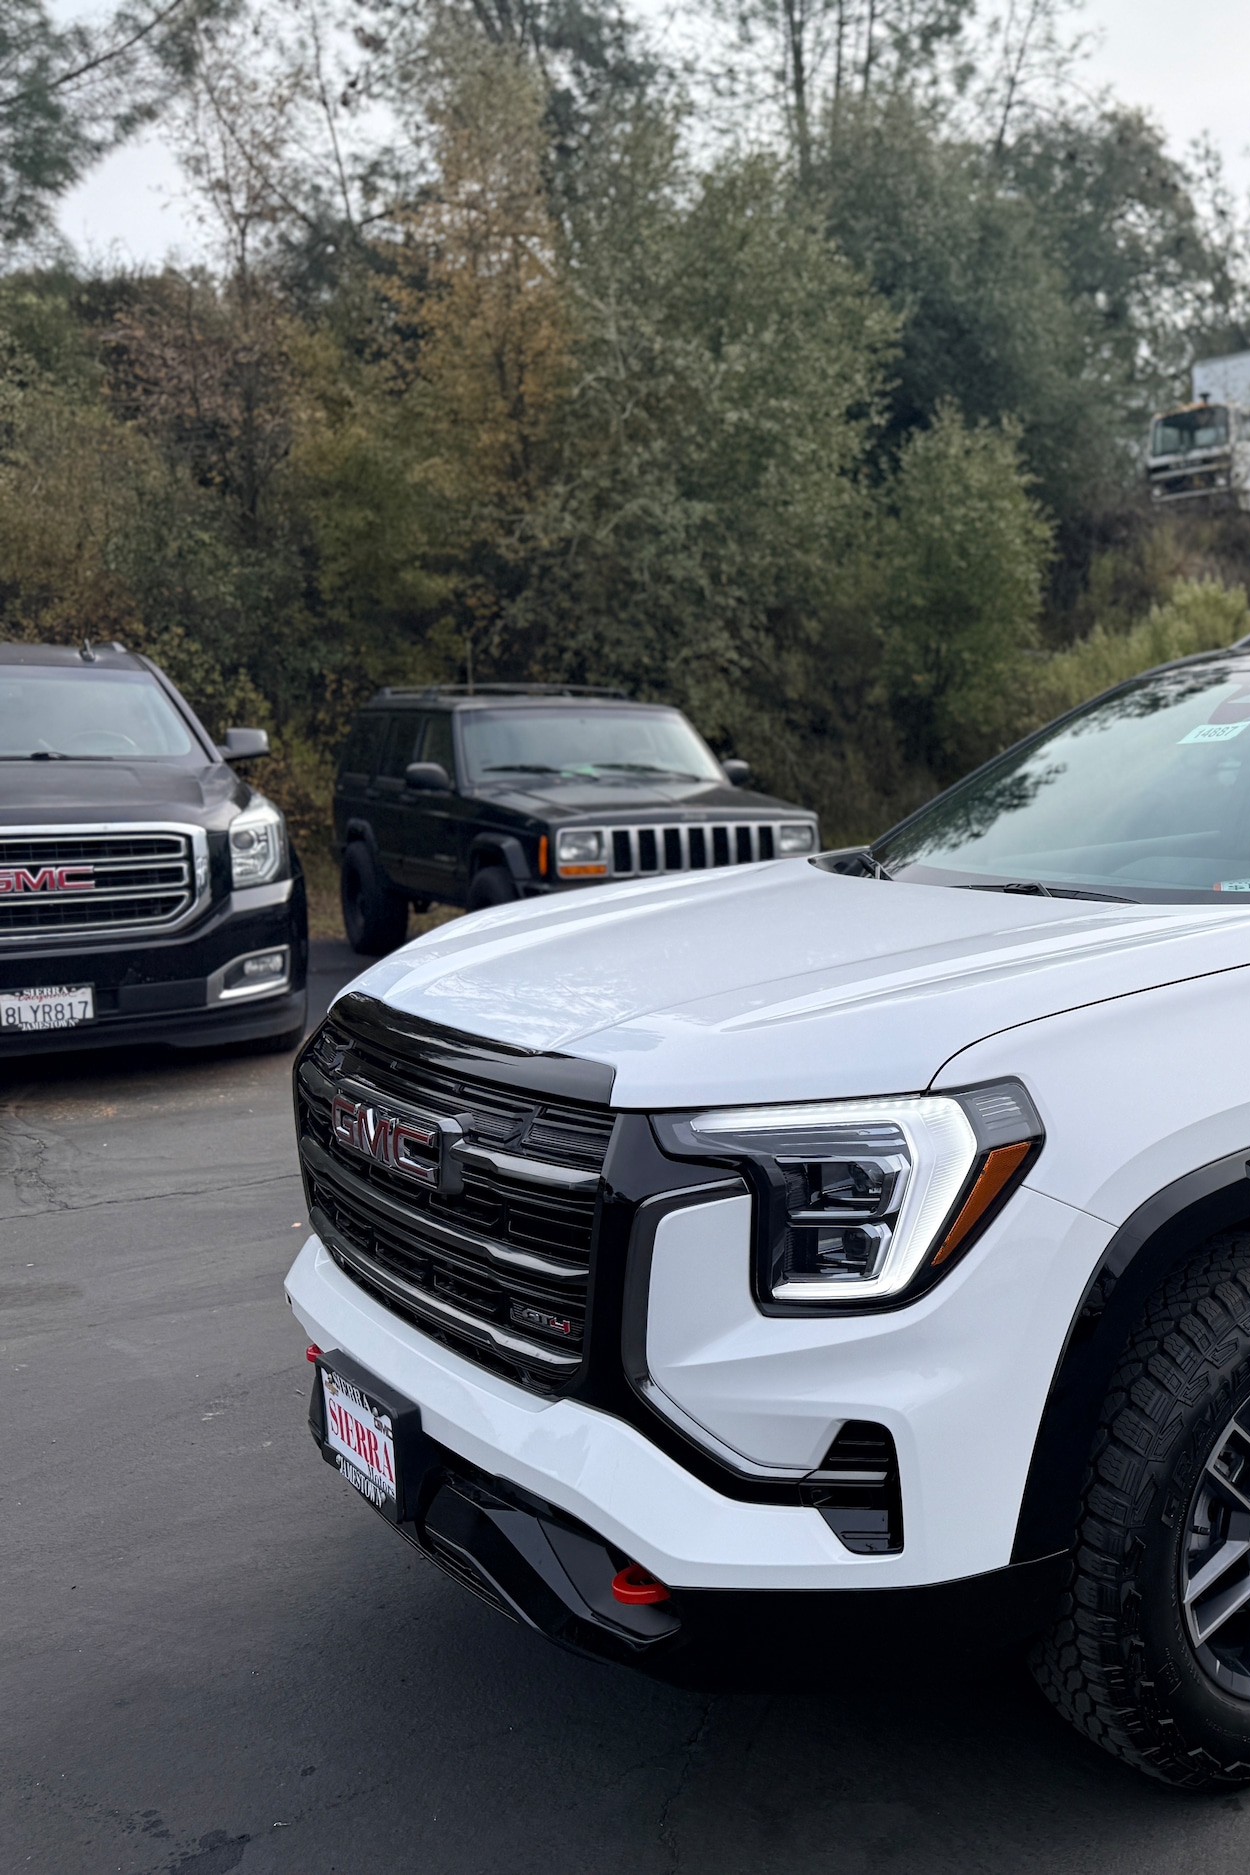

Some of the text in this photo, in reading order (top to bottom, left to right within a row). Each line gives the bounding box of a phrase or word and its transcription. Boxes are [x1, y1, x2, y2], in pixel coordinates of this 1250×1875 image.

[22, 986, 69, 997] SIERRA
[5, 1001, 89, 1025] 8LYR817
[332, 1094, 439, 1184] GMC
[332, 1371, 371, 1413] SIERRA
[328, 1398, 395, 1484] SIERRA
[339, 1457, 383, 1508] JAMESTOWN
[367, 1462, 395, 1498] Motors
